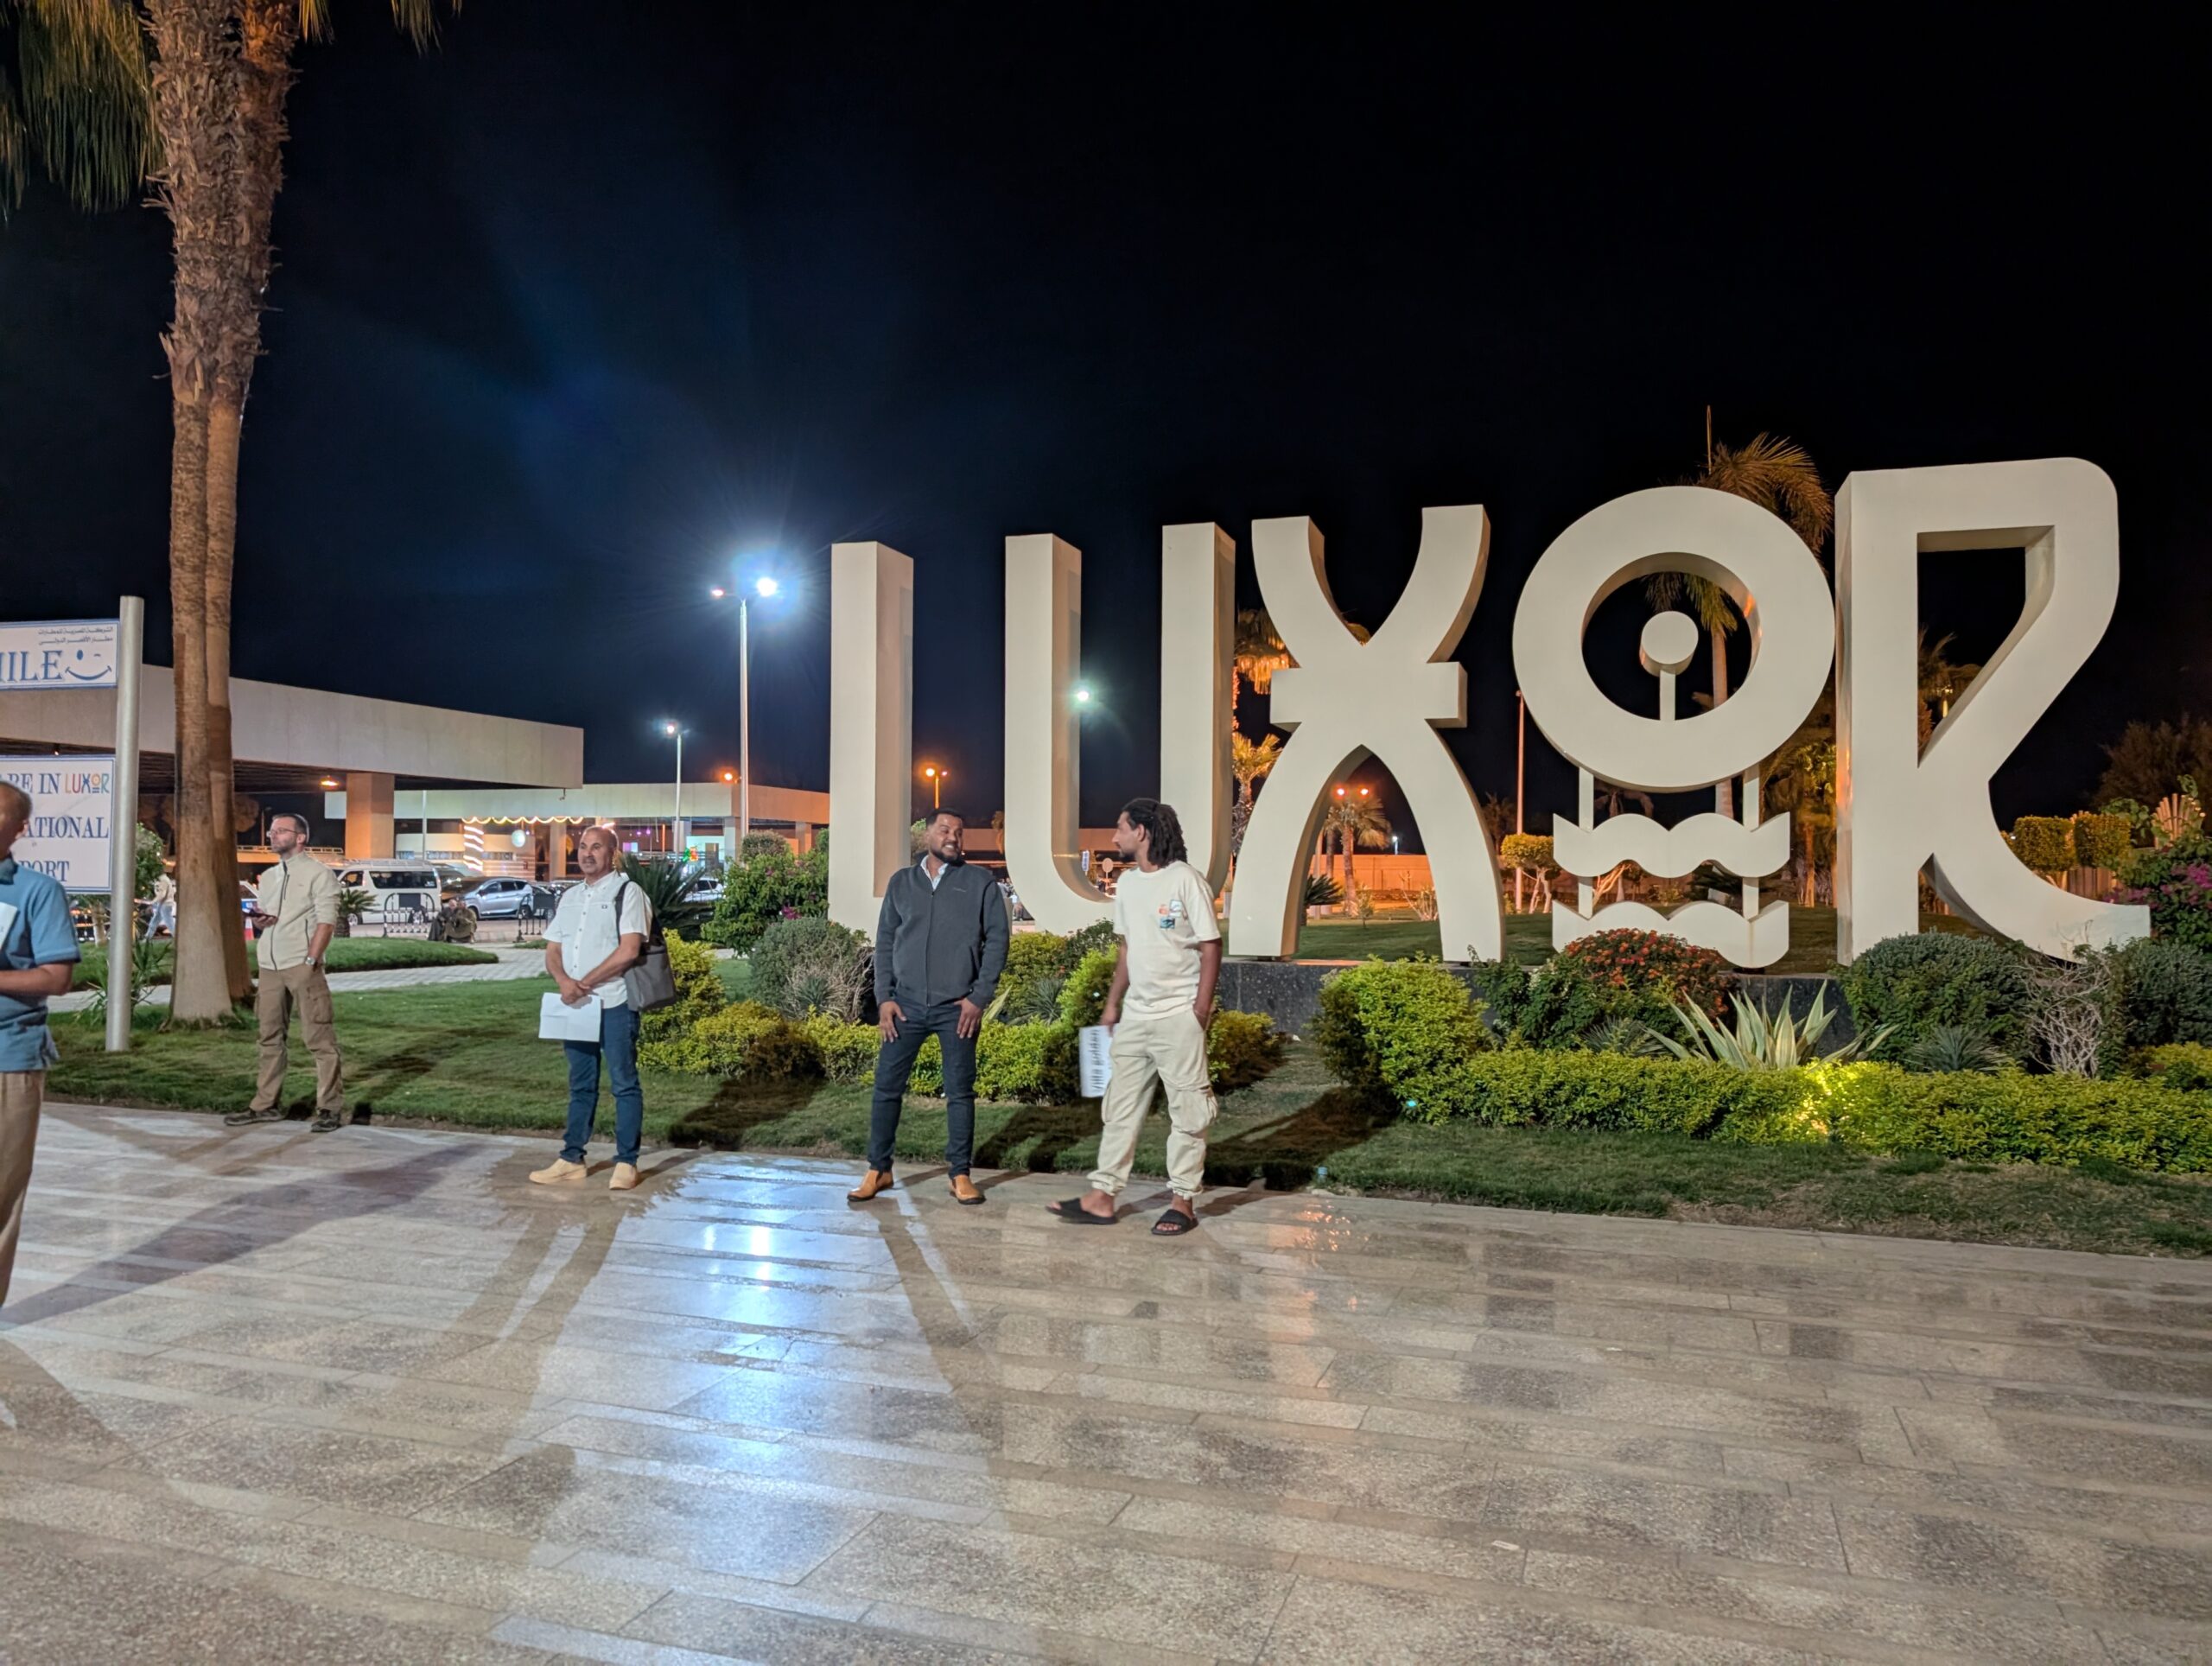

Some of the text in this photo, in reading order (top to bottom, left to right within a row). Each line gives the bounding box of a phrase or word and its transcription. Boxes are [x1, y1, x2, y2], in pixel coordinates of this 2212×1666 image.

[0, 650, 63, 682] ILE
[828, 456, 2152, 969] LUXOR
[37, 773, 61, 794] IN
[65, 773, 110, 794] LUXOR
